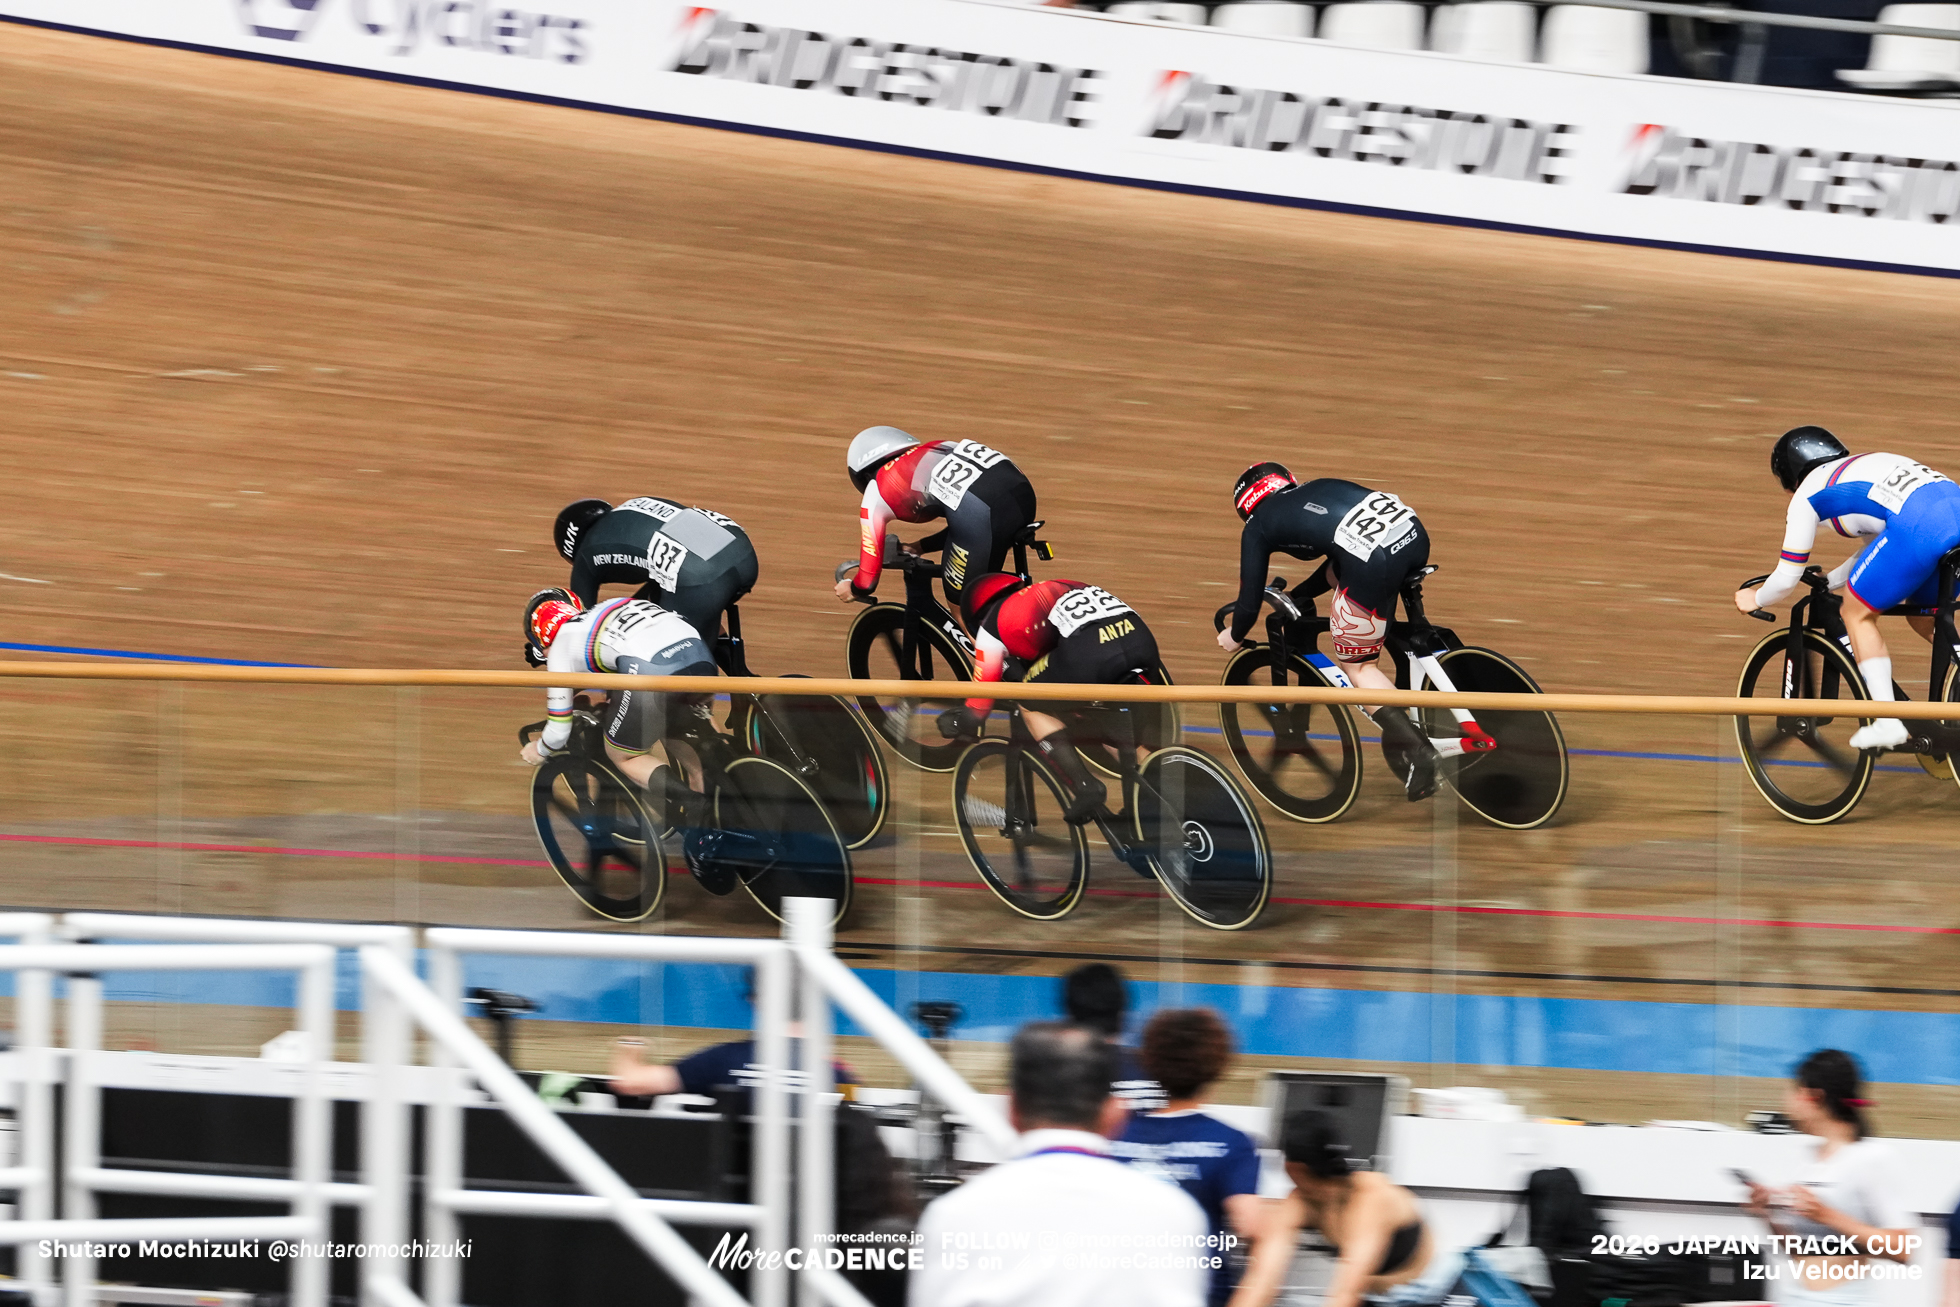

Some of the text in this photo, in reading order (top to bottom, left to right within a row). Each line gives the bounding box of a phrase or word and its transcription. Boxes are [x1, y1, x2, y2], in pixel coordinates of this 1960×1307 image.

[662, 6, 1107, 129] BRIDGESTONE
[1142, 70, 1580, 185] BRIDGESTONE
[858, 443, 889, 466] LAZER
[936, 459, 973, 491] 132
[1244, 480, 1281, 511] Kabuto
[1369, 493, 1408, 523] 142
[563, 521, 579, 561] KASK
[1345, 508, 1386, 543] 142
[593, 554, 650, 570] NEW ZEALAND
[649, 538, 682, 573] 137
[944, 542, 969, 590] CHINA
[1061, 592, 1097, 619] 133
[943, 620, 976, 656] KO
[1099, 618, 1135, 644] ANTA
[1784, 658, 1793, 698] ope
